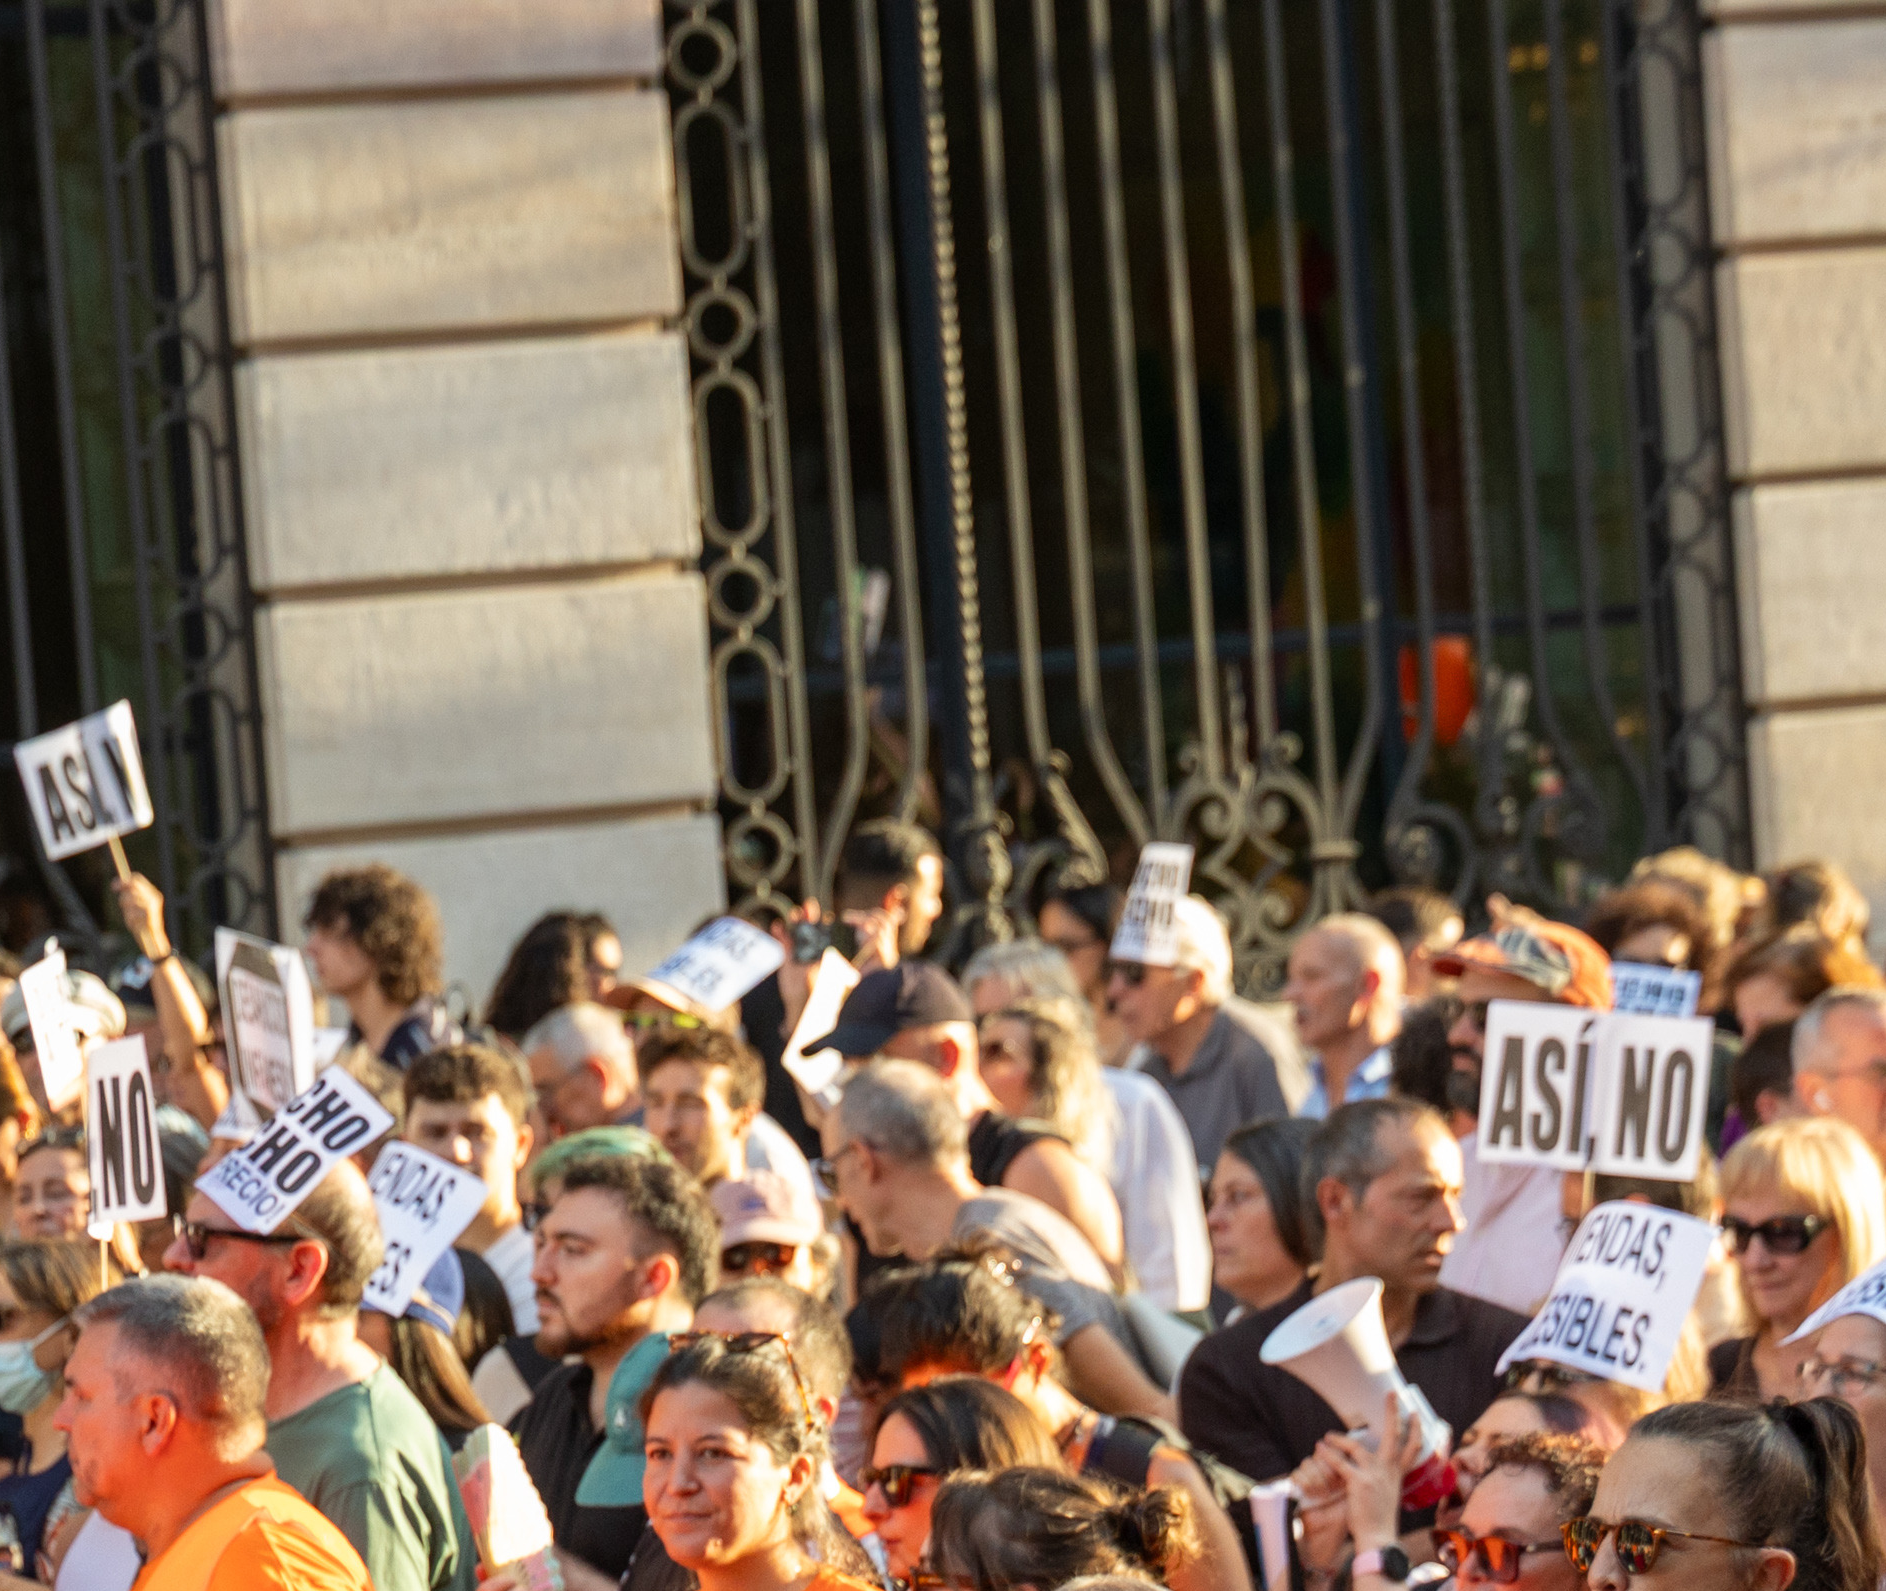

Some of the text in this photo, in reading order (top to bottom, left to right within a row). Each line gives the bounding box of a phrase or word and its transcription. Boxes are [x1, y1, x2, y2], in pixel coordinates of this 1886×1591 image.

[98, 1070, 155, 1209] NO
[285, 1078, 371, 1151] CHO
[1488, 1018, 1693, 1167] ASÍ, NO
